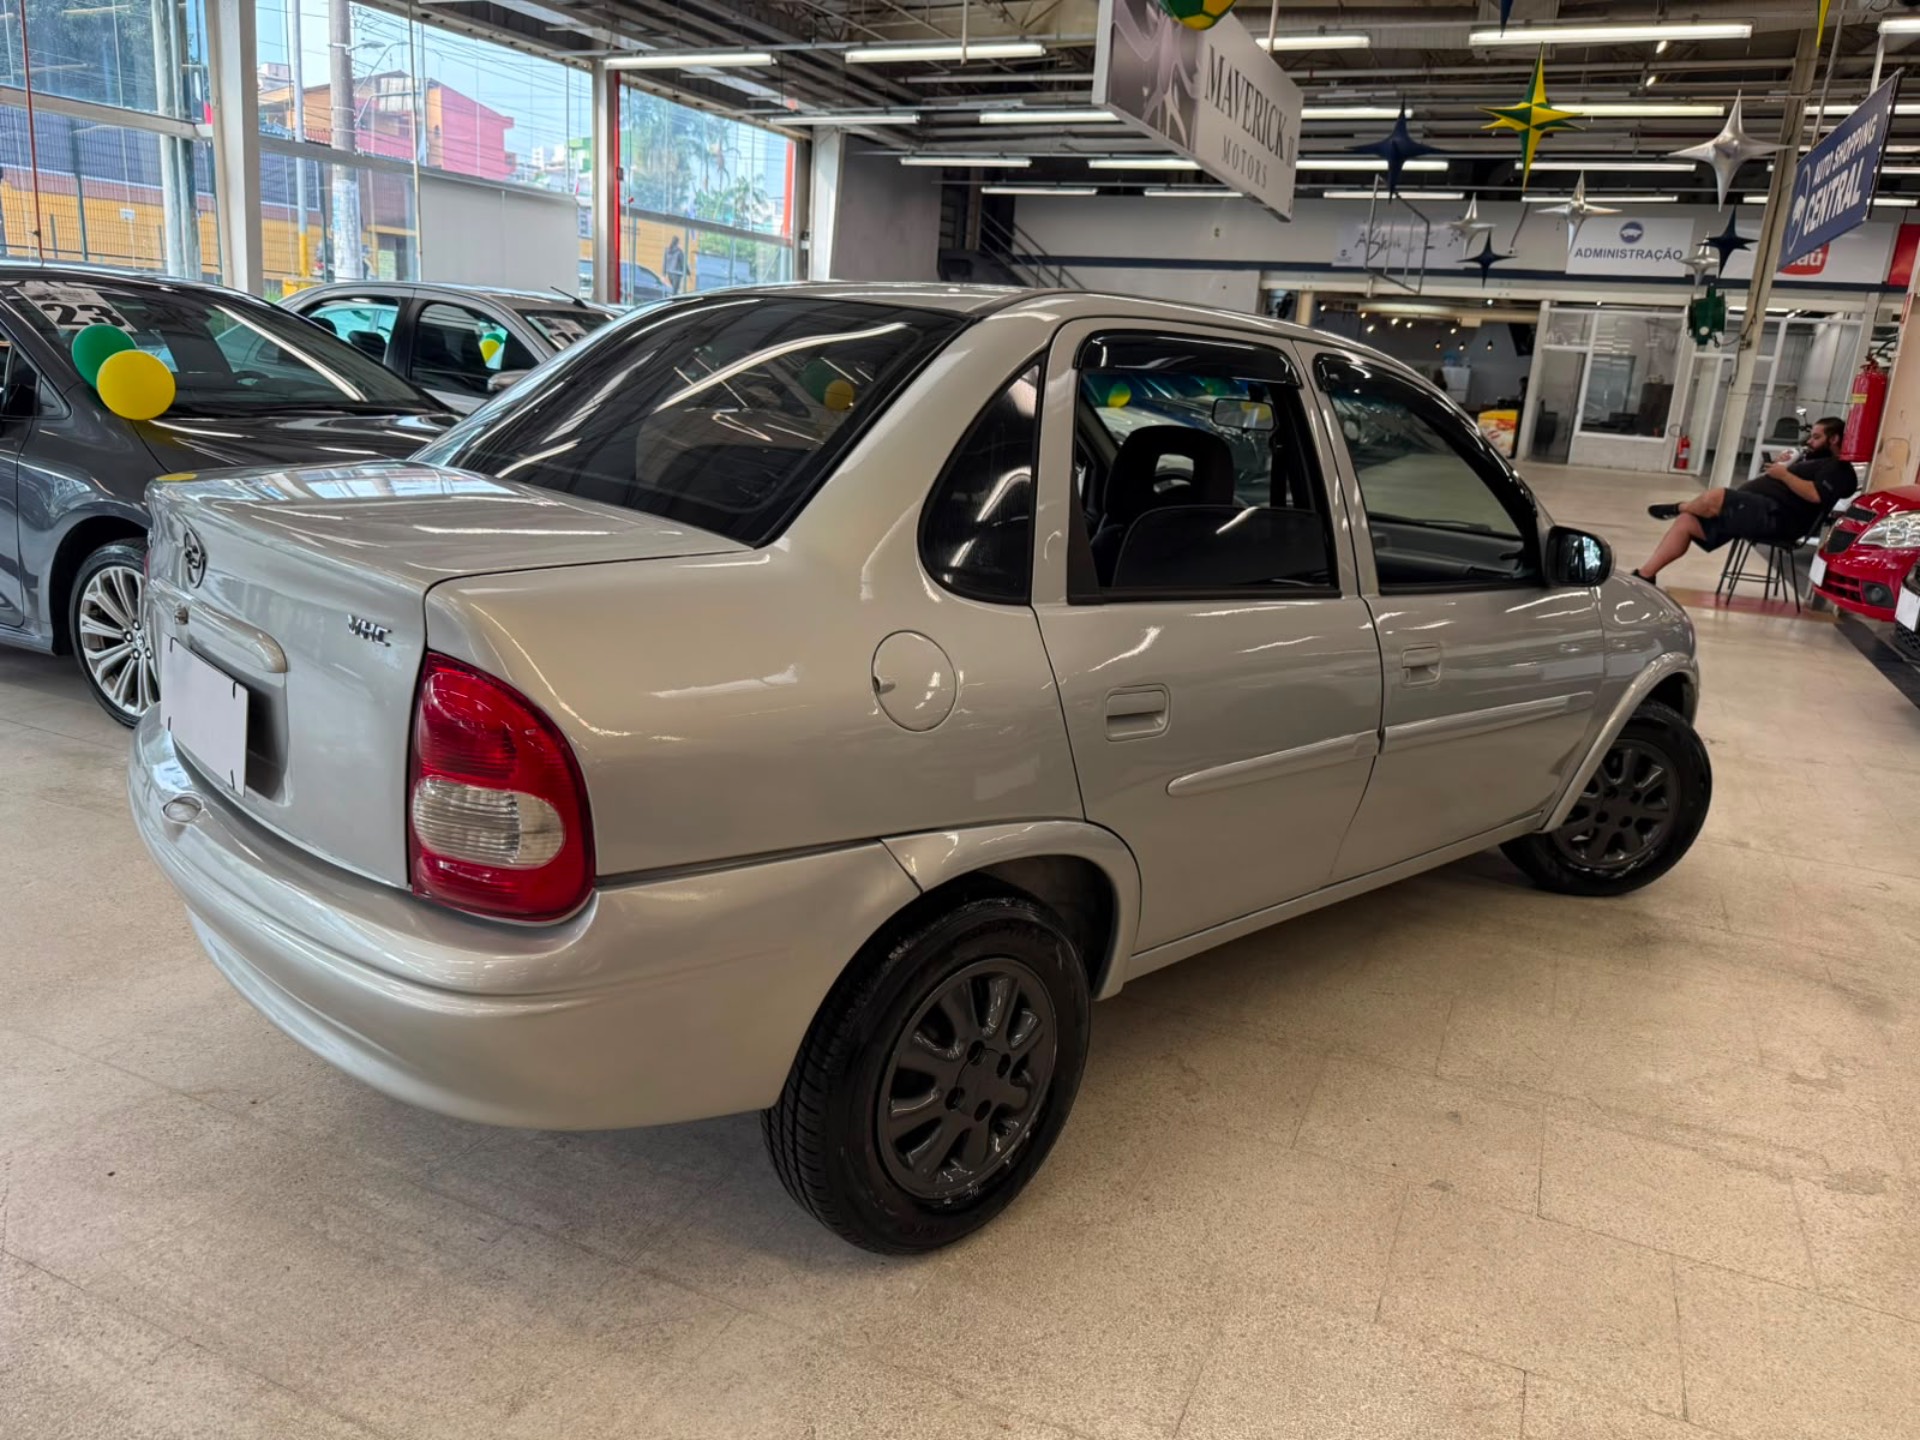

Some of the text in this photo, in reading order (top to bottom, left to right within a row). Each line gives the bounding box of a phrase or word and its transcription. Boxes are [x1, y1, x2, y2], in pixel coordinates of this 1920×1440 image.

[1205, 44, 1287, 160] MAVERICK
[1221, 134, 1268, 189] MOTORS
[1812, 113, 1879, 188] AUTO SHOPPING
[1803, 156, 1865, 236] CENTRAL
[1574, 246, 1683, 261] ADMINISTRAÇÃO
